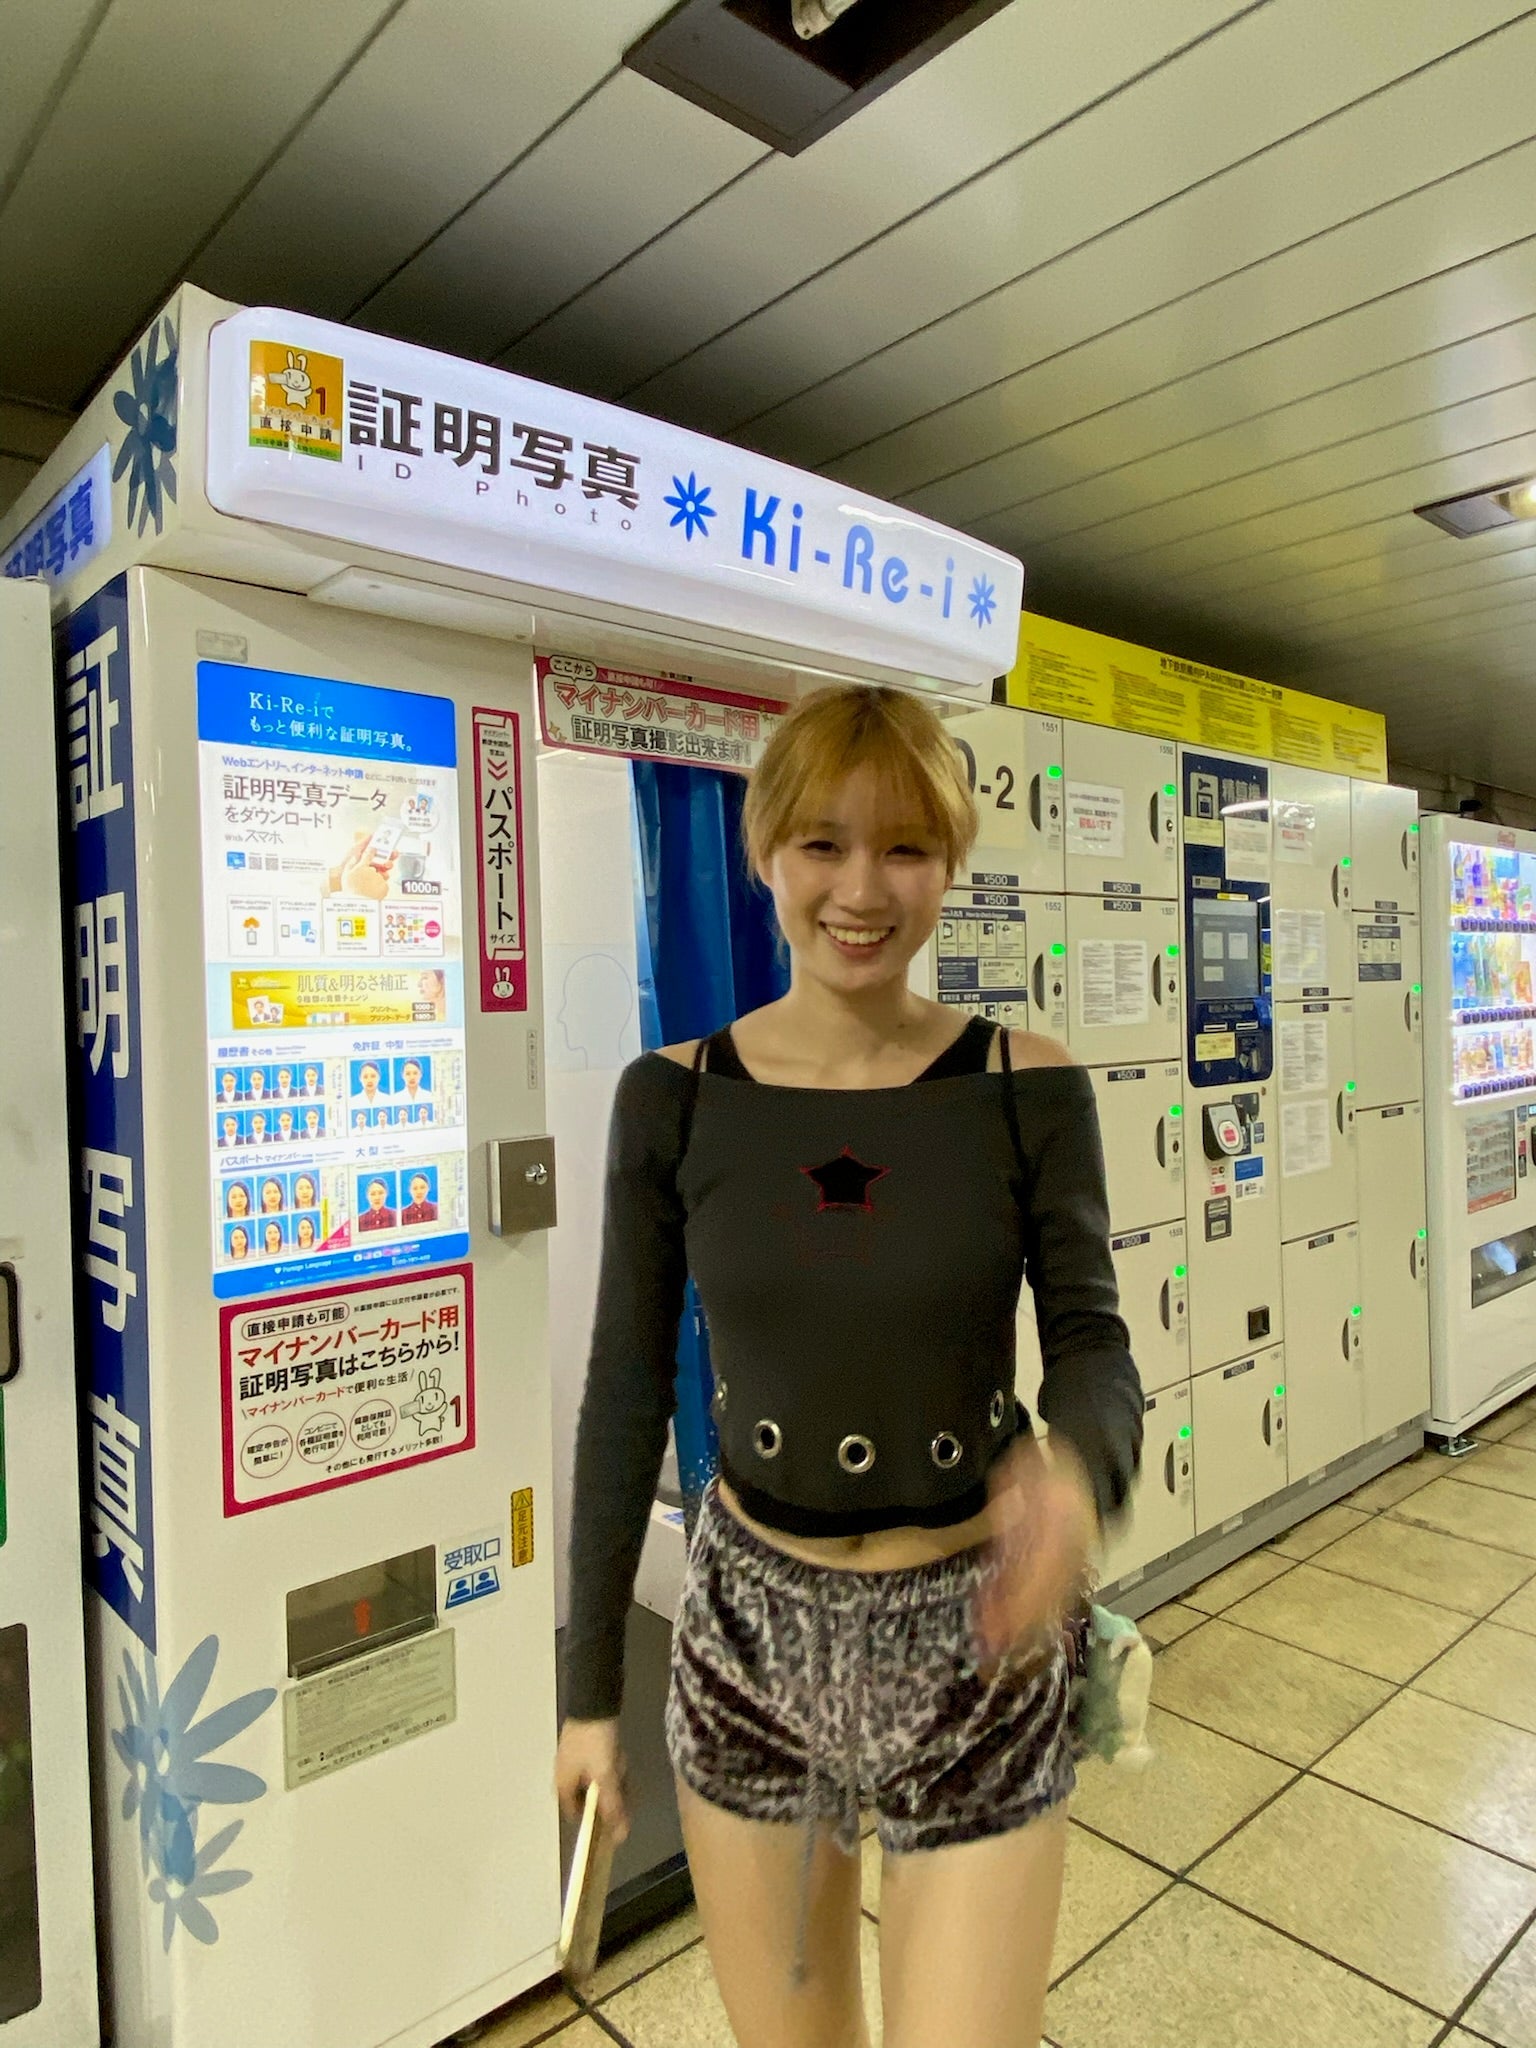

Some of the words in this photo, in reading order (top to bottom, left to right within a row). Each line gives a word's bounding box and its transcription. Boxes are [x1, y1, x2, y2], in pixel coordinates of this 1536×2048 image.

[260, 416, 332, 442] 直接申請
[347, 380, 641, 511] 証明写真
[358, 454, 412, 480] ID
[475, 480, 635, 532] Photo
[741, 486, 958, 619] Ki-Re-i
[553, 659, 594, 680] ここから
[249, 691, 334, 718] Ki-Re-iで
[553, 681, 761, 742] マイナンバーカード用
[249, 714, 413, 752] もっと便利な証明写真。
[571, 715, 753, 766] 証明写真撮影出来ます!
[223, 773, 388, 811] 証明写真データ
[224, 805, 333, 830] をダウンロード!
[244, 829, 285, 845] スマホ
[484, 785, 515, 931] パスポート
[489, 933, 516, 946] サイズ
[296, 972, 409, 994] 肌質&明るさ補正
[385, 1039, 405, 1050] 中型
[65, 627, 146, 1604] 証明写真
[219, 1153, 263, 1167] パスポート
[356, 1145, 379, 1159] 大型
[237, 1304, 460, 1368] マイナンバーカード用
[246, 1306, 346, 1338] 直接申請も可能
[239, 1331, 460, 1400] 証明写真はこちらから!
[246, 1371, 410, 1418] マイナンバーカードで便利な生活
[442, 1535, 501, 1576] 受取口
